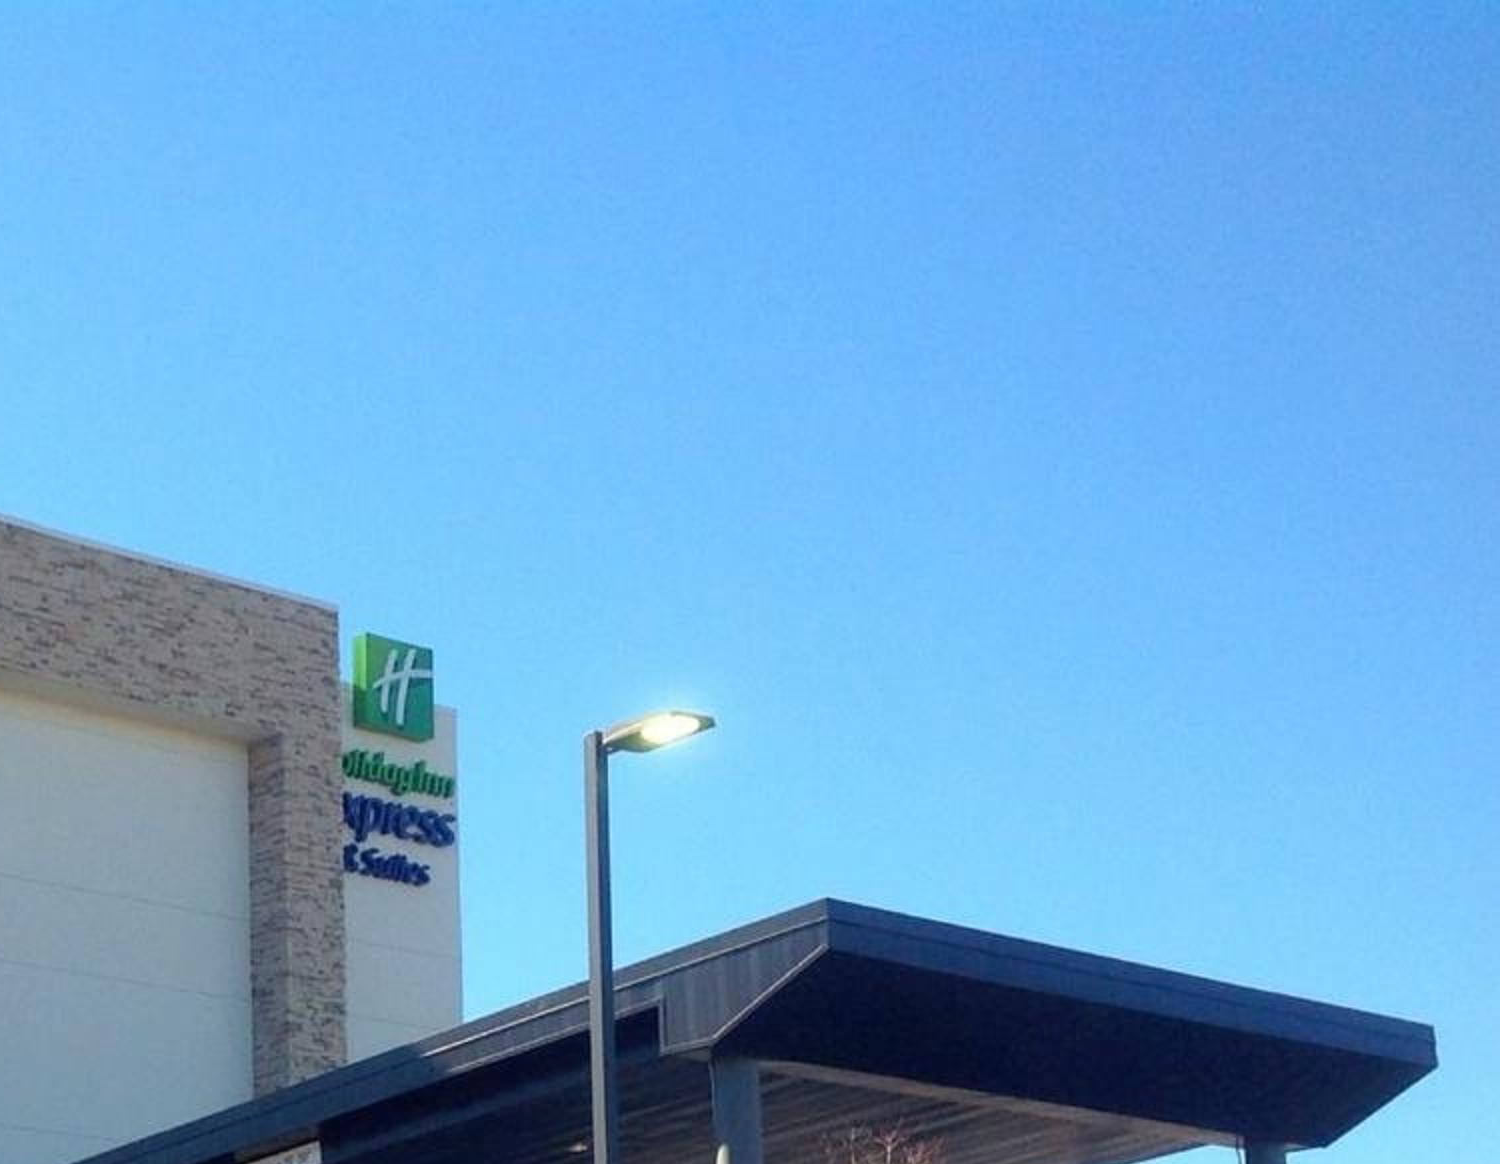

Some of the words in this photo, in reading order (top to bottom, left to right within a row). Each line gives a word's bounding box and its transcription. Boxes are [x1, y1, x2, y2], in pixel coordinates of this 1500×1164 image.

[342, 748, 411, 796] oliday
[342, 791, 456, 848] xpress
[360, 847, 431, 887] Suites
